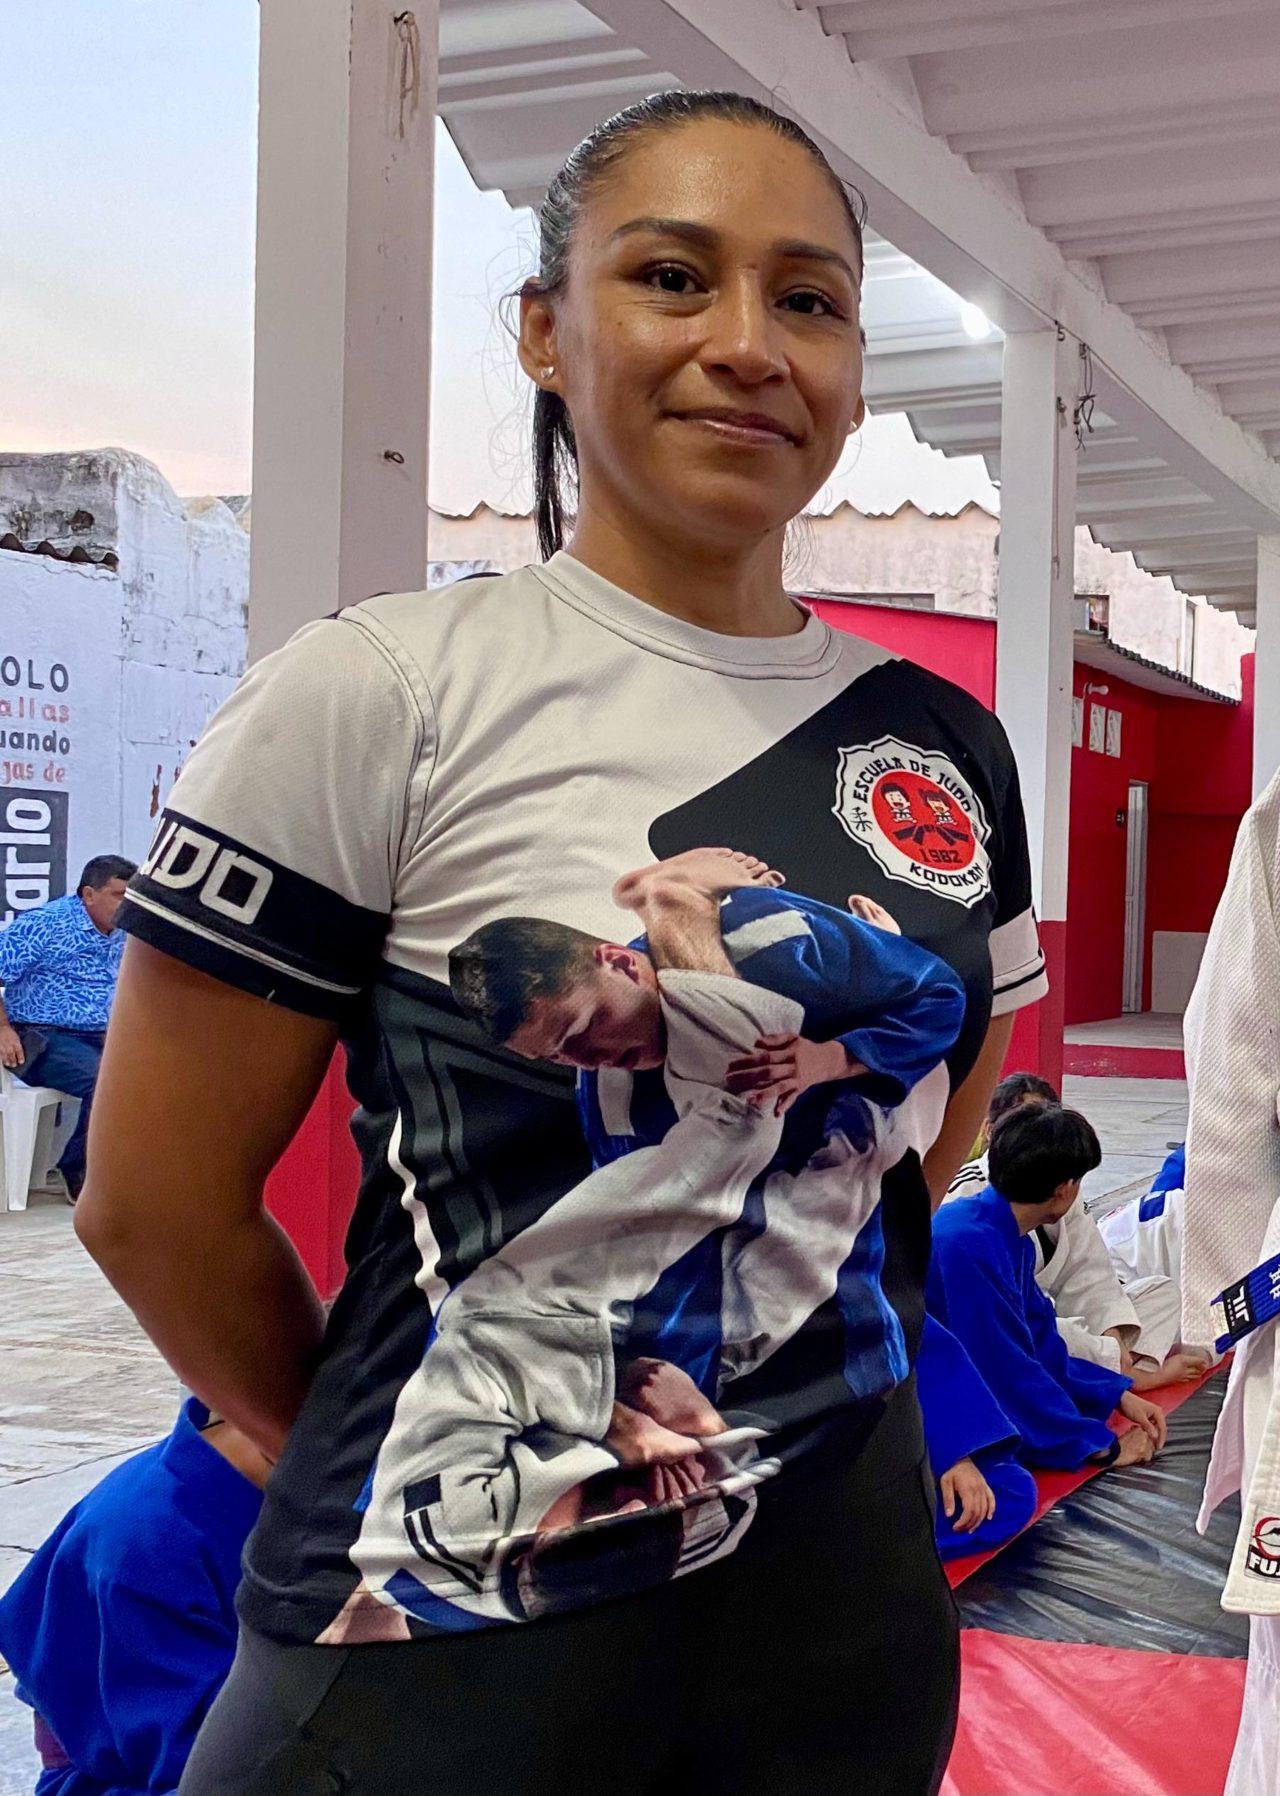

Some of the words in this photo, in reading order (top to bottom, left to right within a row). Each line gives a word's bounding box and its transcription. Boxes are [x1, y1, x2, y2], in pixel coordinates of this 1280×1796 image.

[43, 760, 66, 783] de
[853, 757, 906, 803] ESCUELA
[909, 759, 931, 777] DE
[937, 772, 971, 812] JUDO
[919, 848, 963, 864] 1982
[910, 862, 984, 887] KODOKAN
